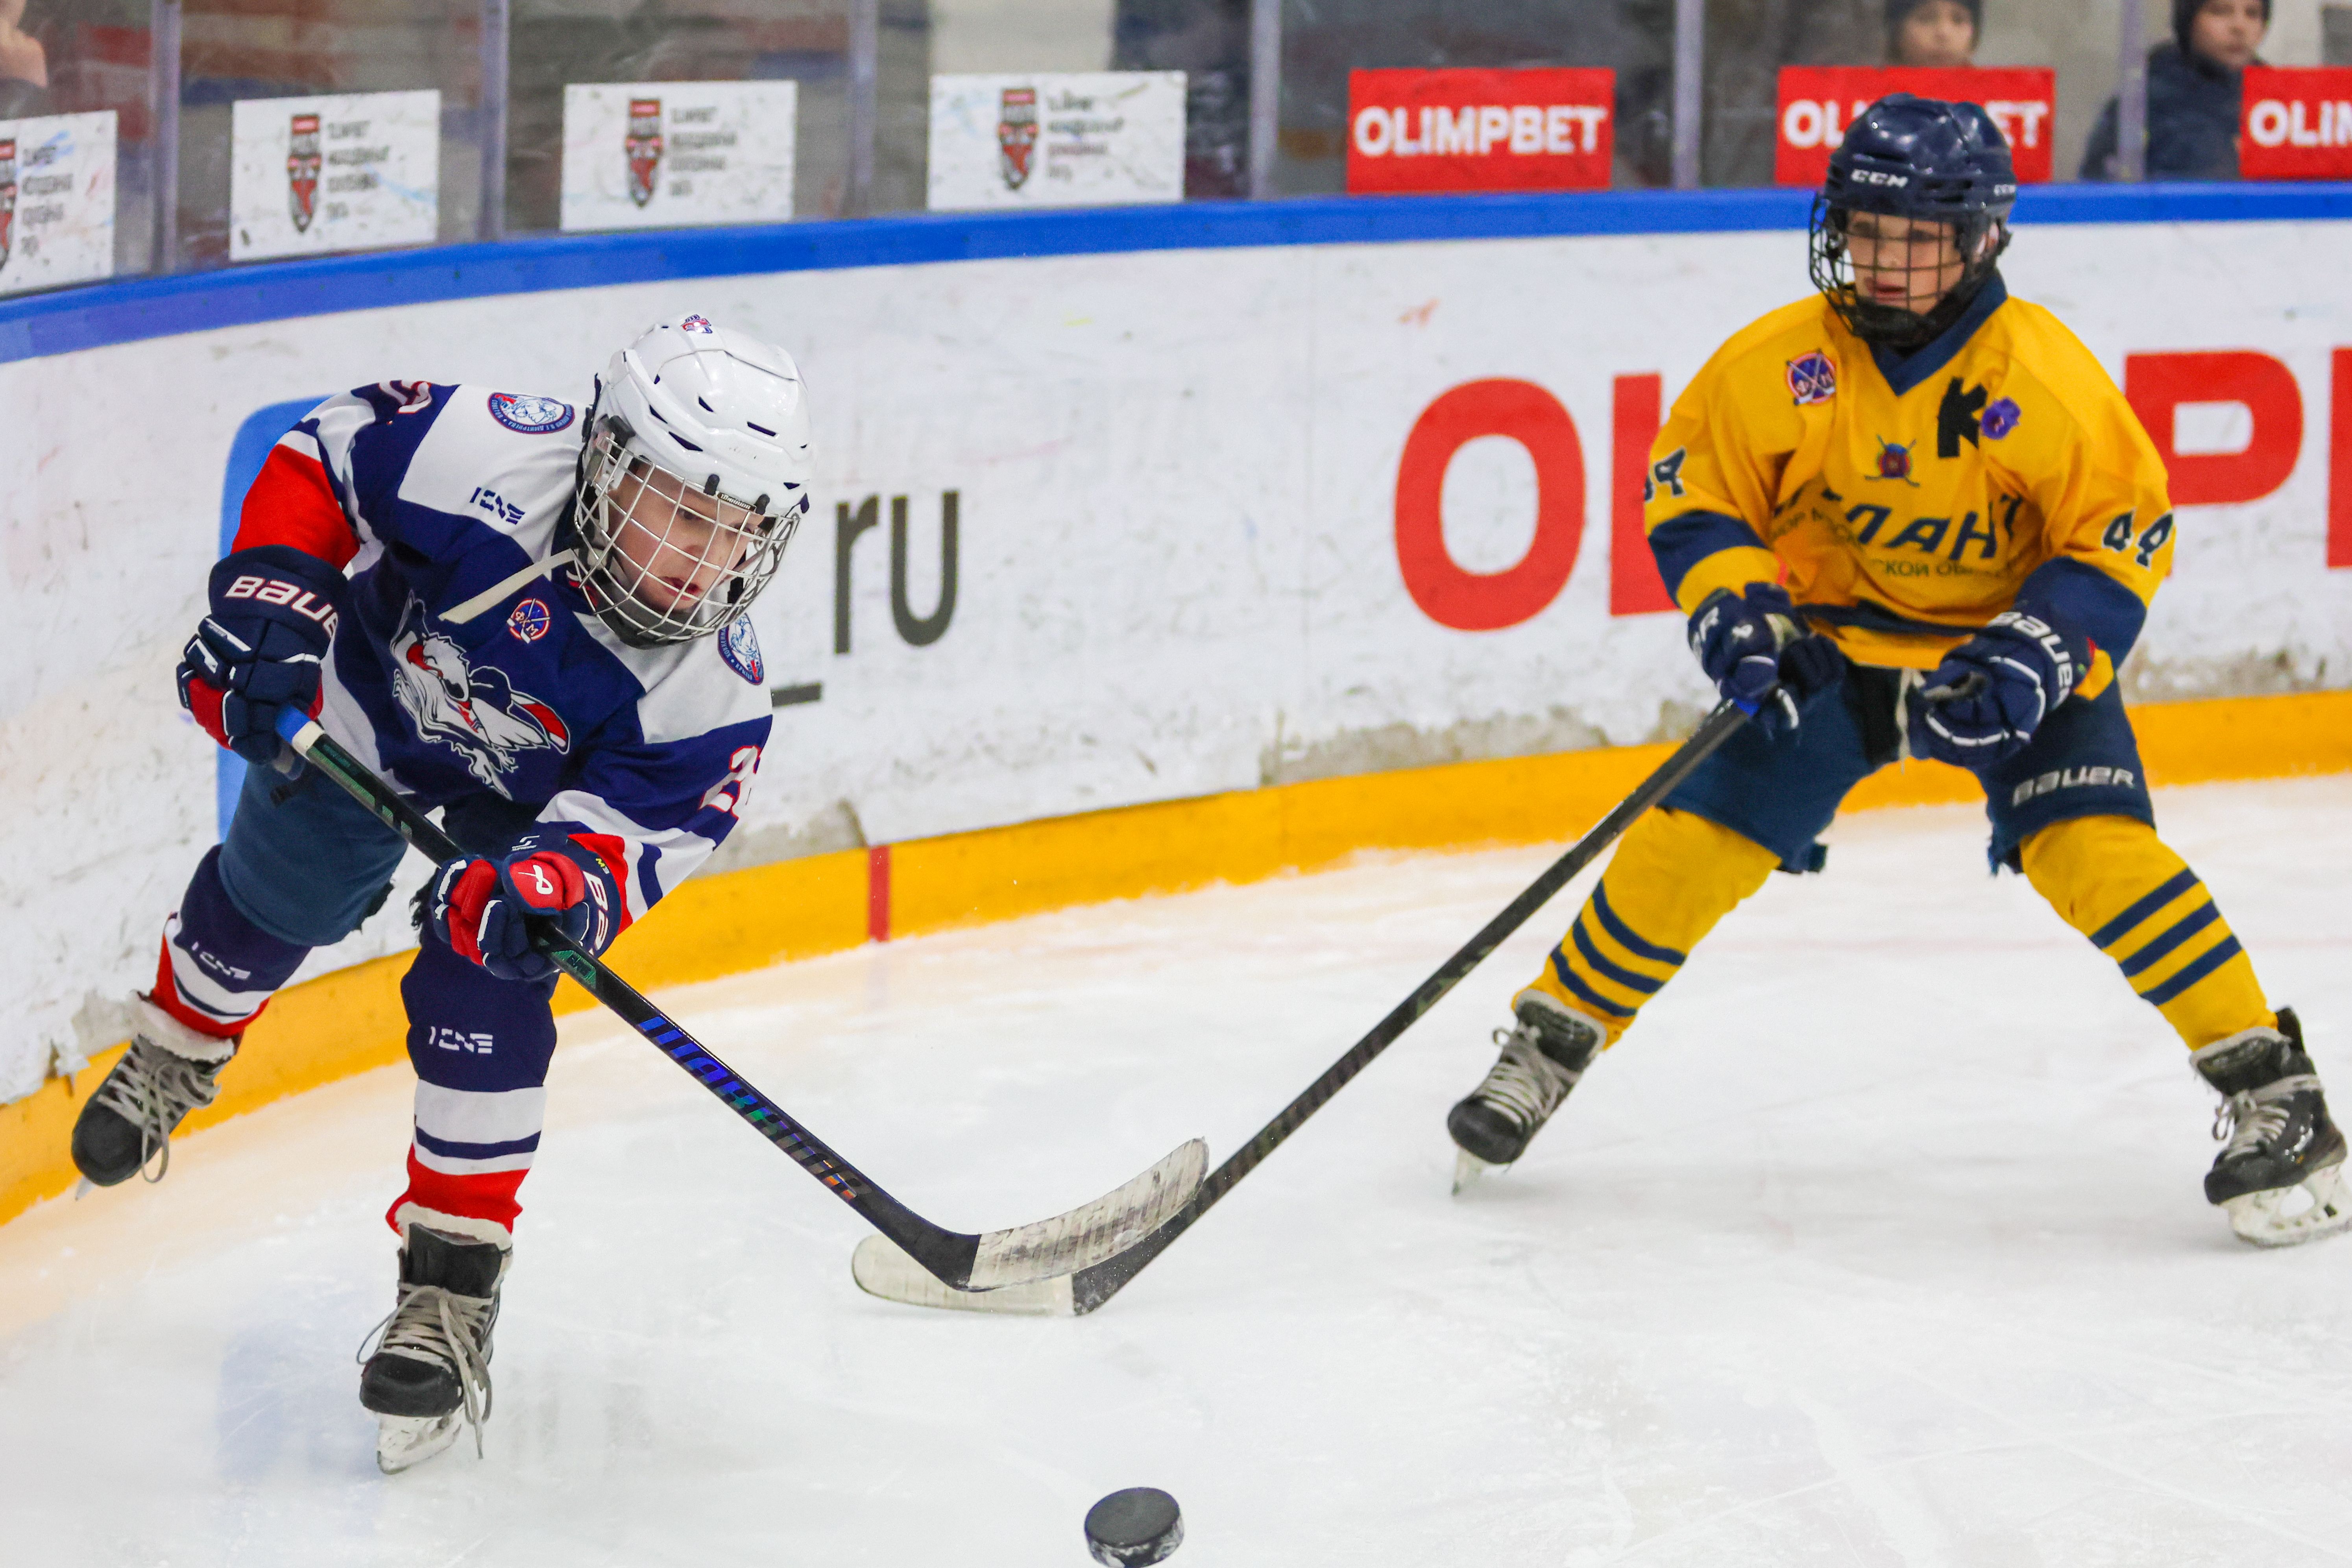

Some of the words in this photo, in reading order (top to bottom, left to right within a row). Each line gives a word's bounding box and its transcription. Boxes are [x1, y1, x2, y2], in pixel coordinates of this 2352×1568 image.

[1354, 105, 1607, 156] OLIMPBET
[1850, 169, 1909, 188] CCM
[720, 493, 752, 510] WARRIOR
[2102, 508, 2176, 571] 44
[224, 575, 338, 639] BAUE
[2011, 765, 2137, 807] BAUER
